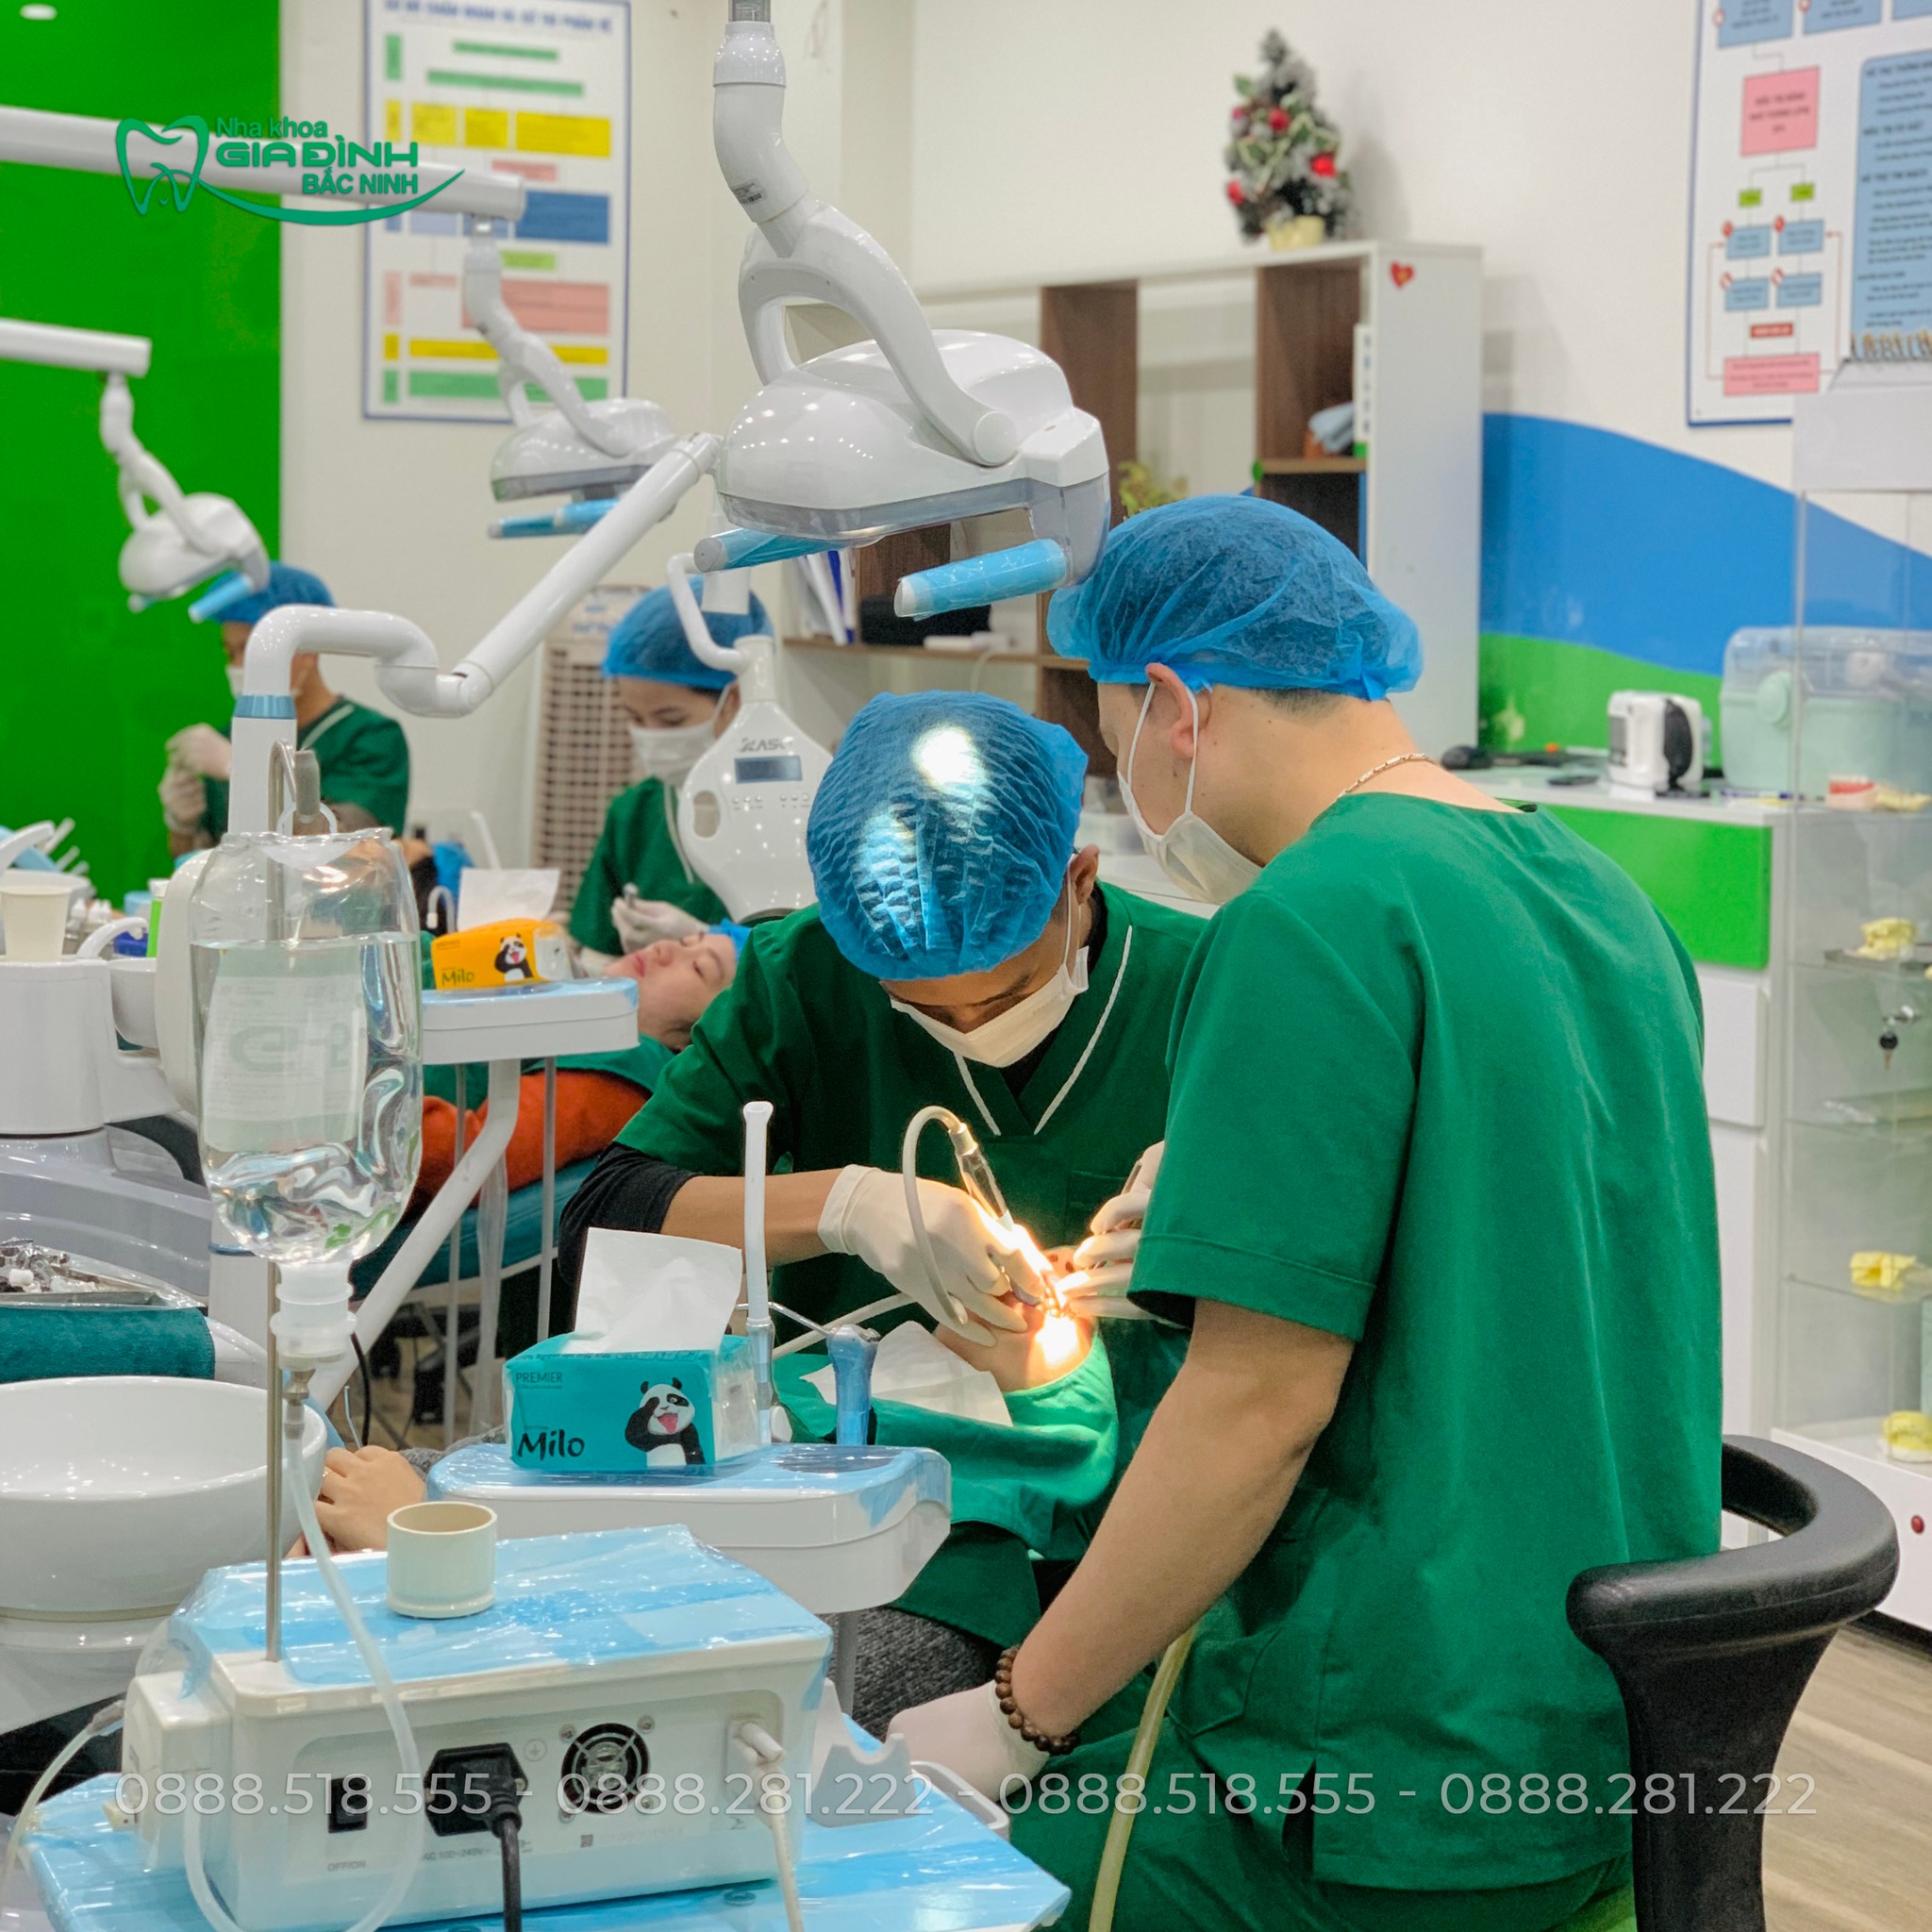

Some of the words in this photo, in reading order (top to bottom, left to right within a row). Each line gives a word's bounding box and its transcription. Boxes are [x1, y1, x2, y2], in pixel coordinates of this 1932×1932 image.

[441, 967, 475, 986] Milo
[515, 1372, 563, 1383] PREMIER
[517, 1429, 585, 1461] Milo
